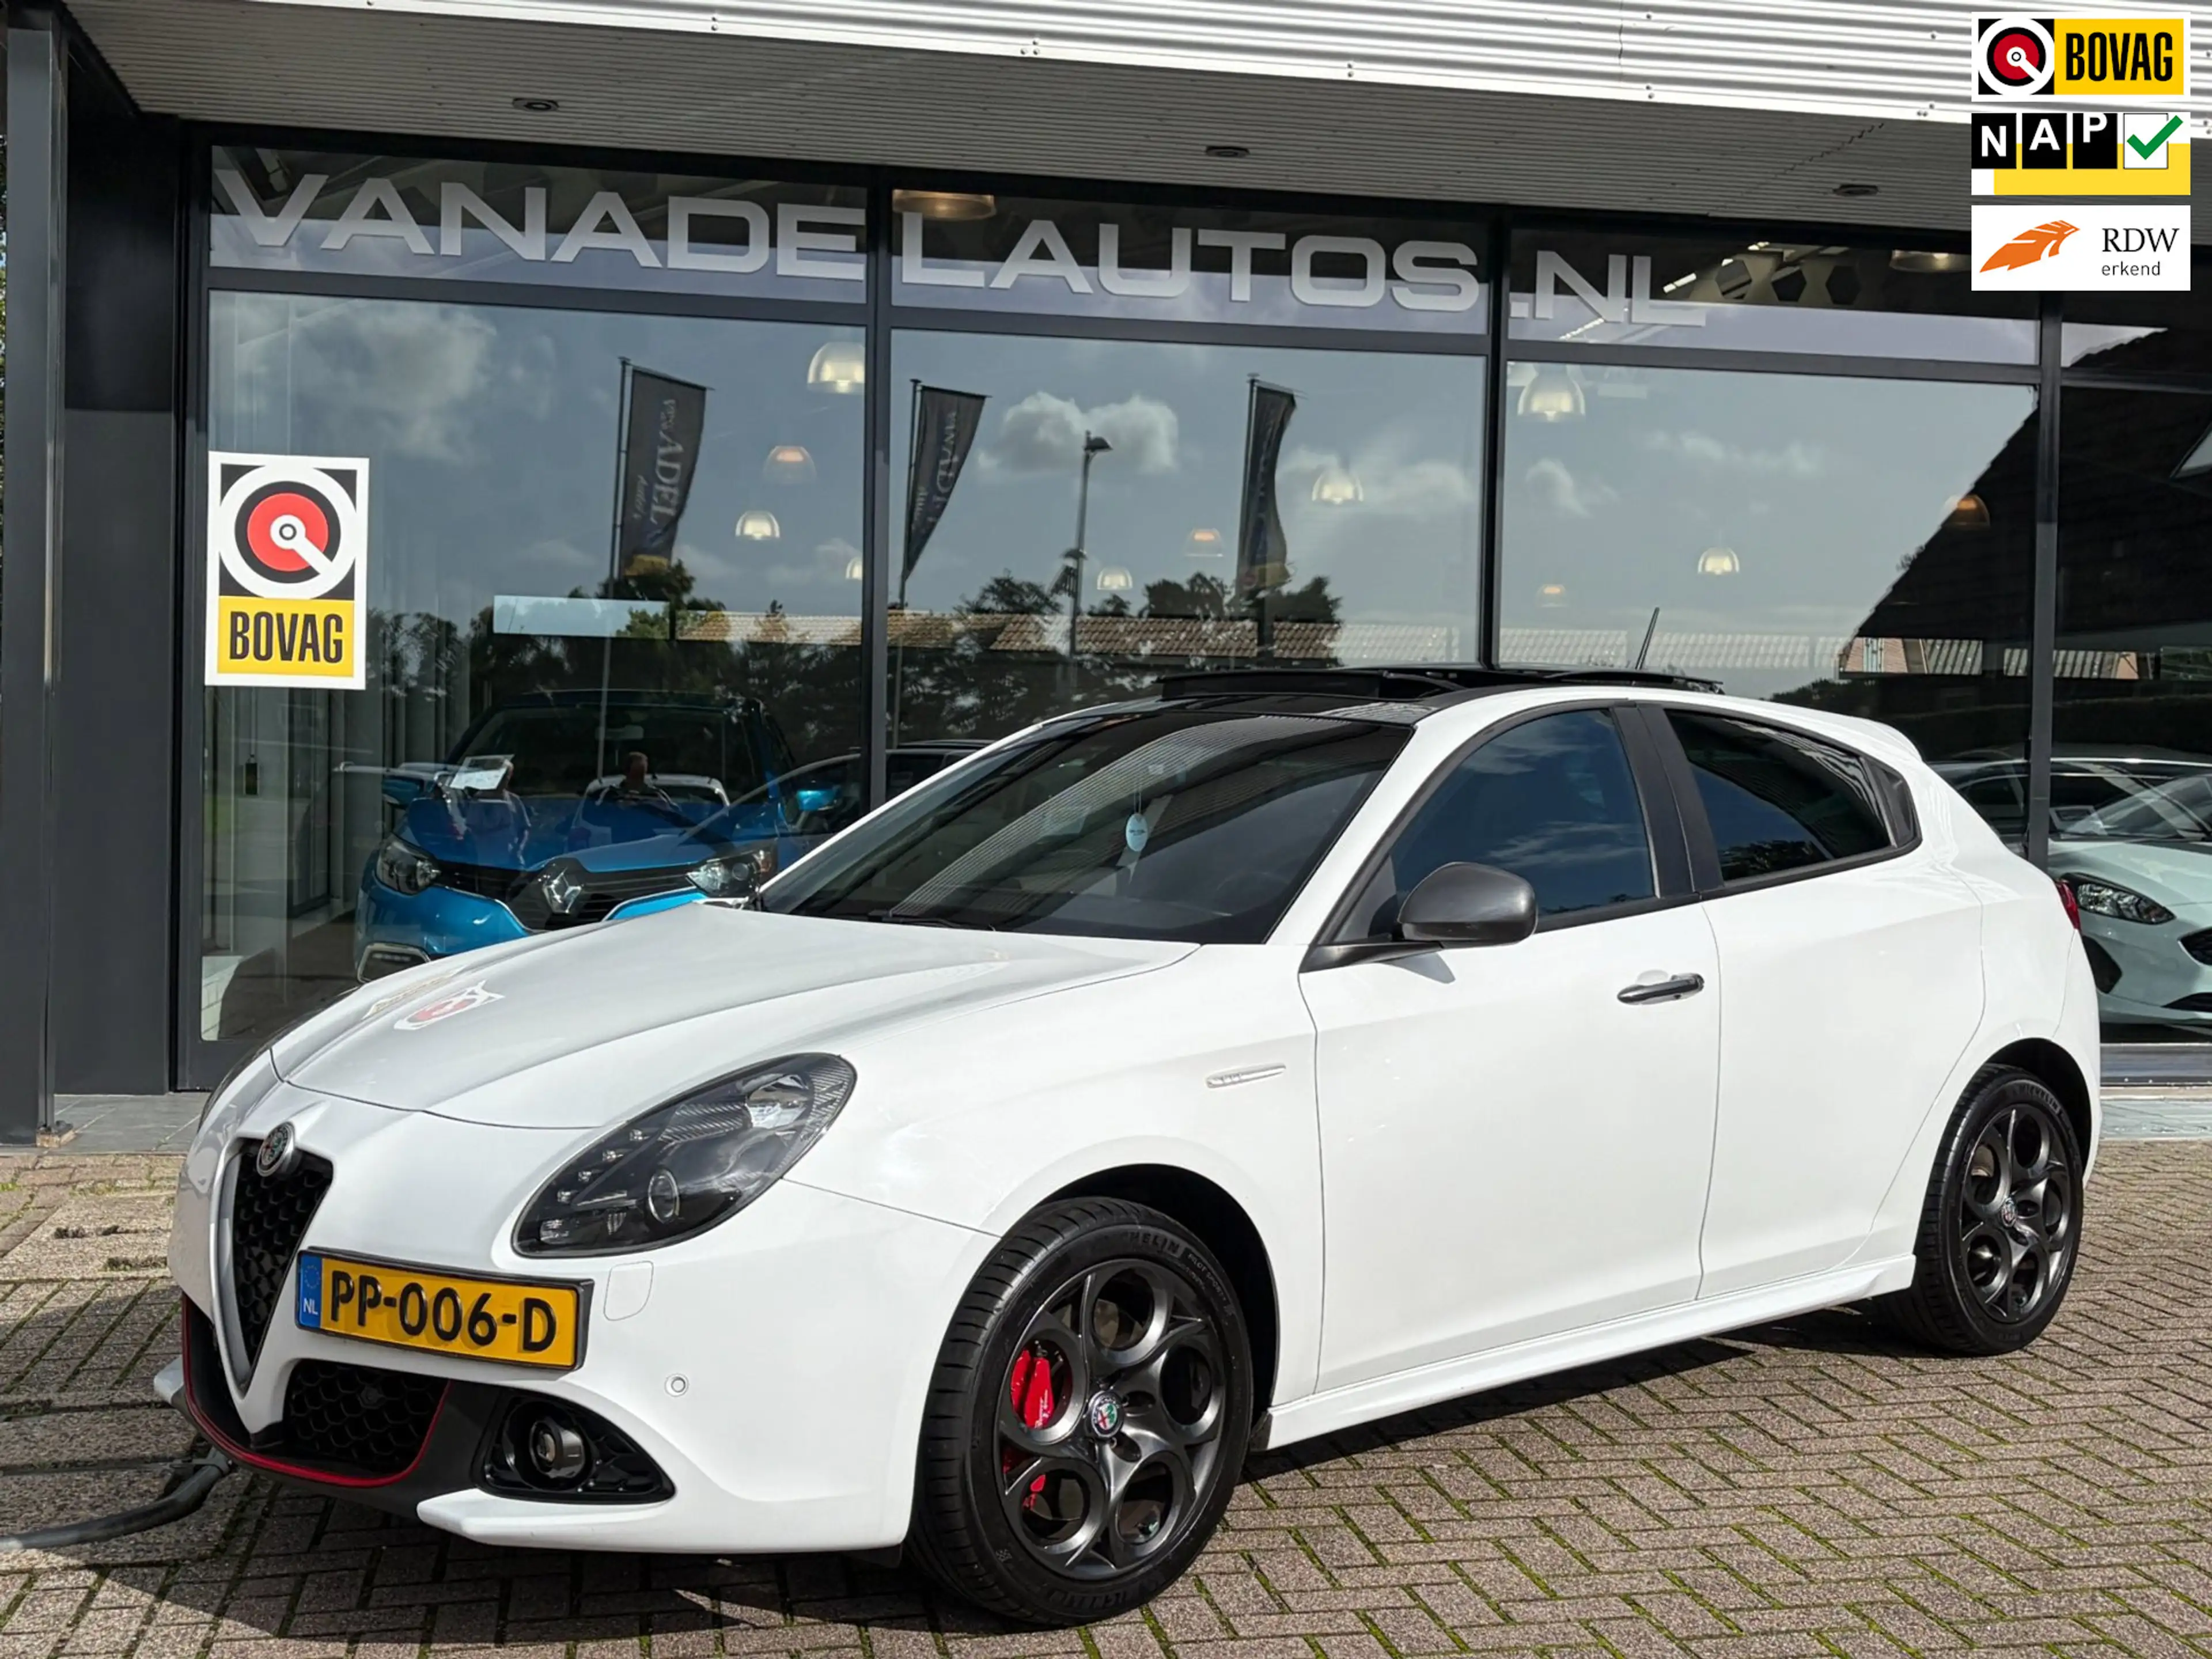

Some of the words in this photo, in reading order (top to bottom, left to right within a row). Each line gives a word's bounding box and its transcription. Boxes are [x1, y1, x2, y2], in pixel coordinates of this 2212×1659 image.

[229, 611, 343, 664] BOVAG
[303, 1298, 319, 1316] NL
[331, 1270, 556, 1352] PP-006-D
